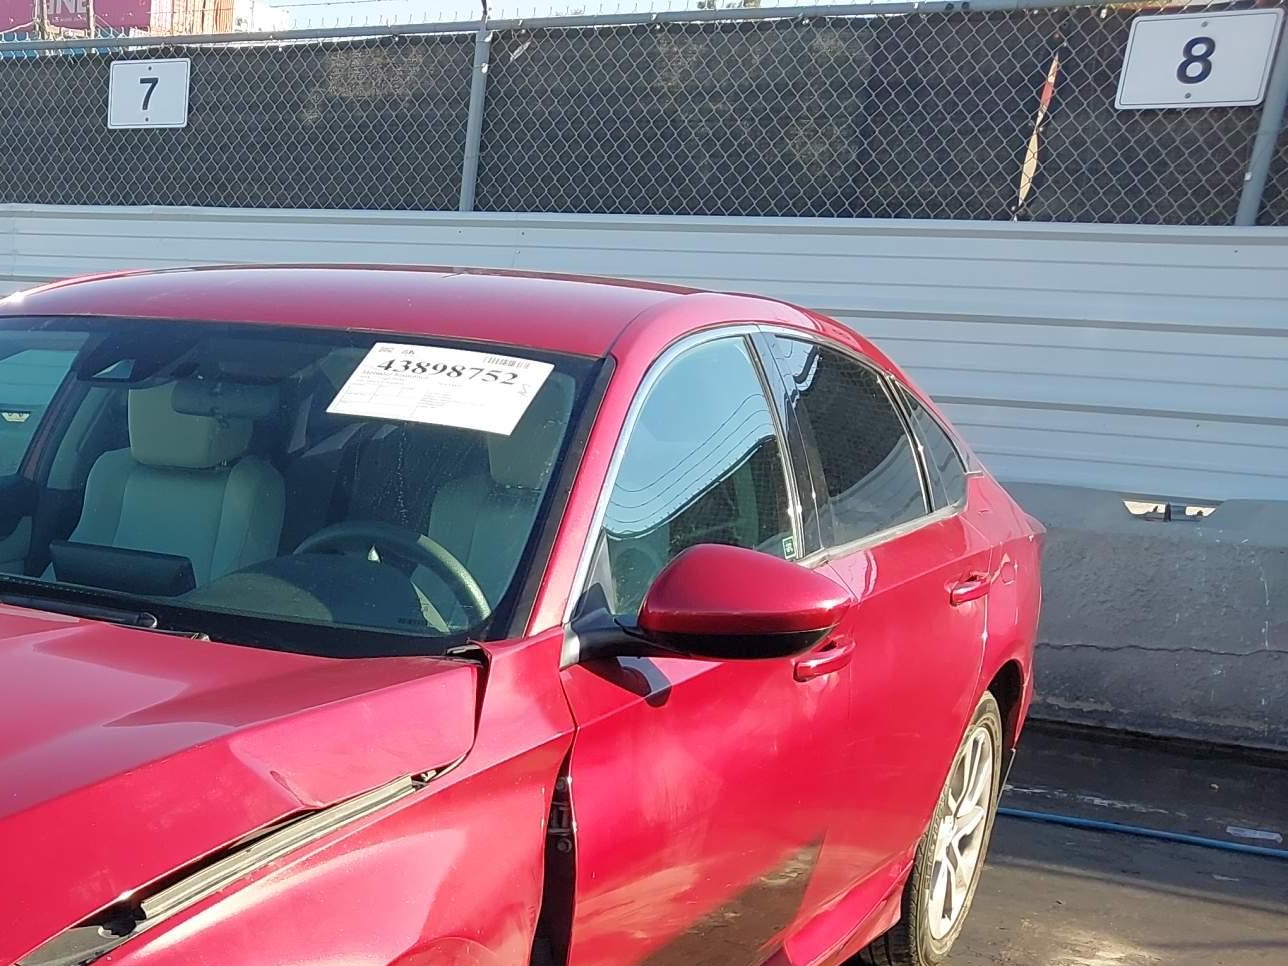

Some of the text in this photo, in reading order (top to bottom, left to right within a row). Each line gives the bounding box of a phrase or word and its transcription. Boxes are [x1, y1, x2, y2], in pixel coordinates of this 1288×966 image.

[1176, 36, 1216, 84] 8
[139, 77, 159, 111] 7
[376, 359, 519, 385] 43898752
